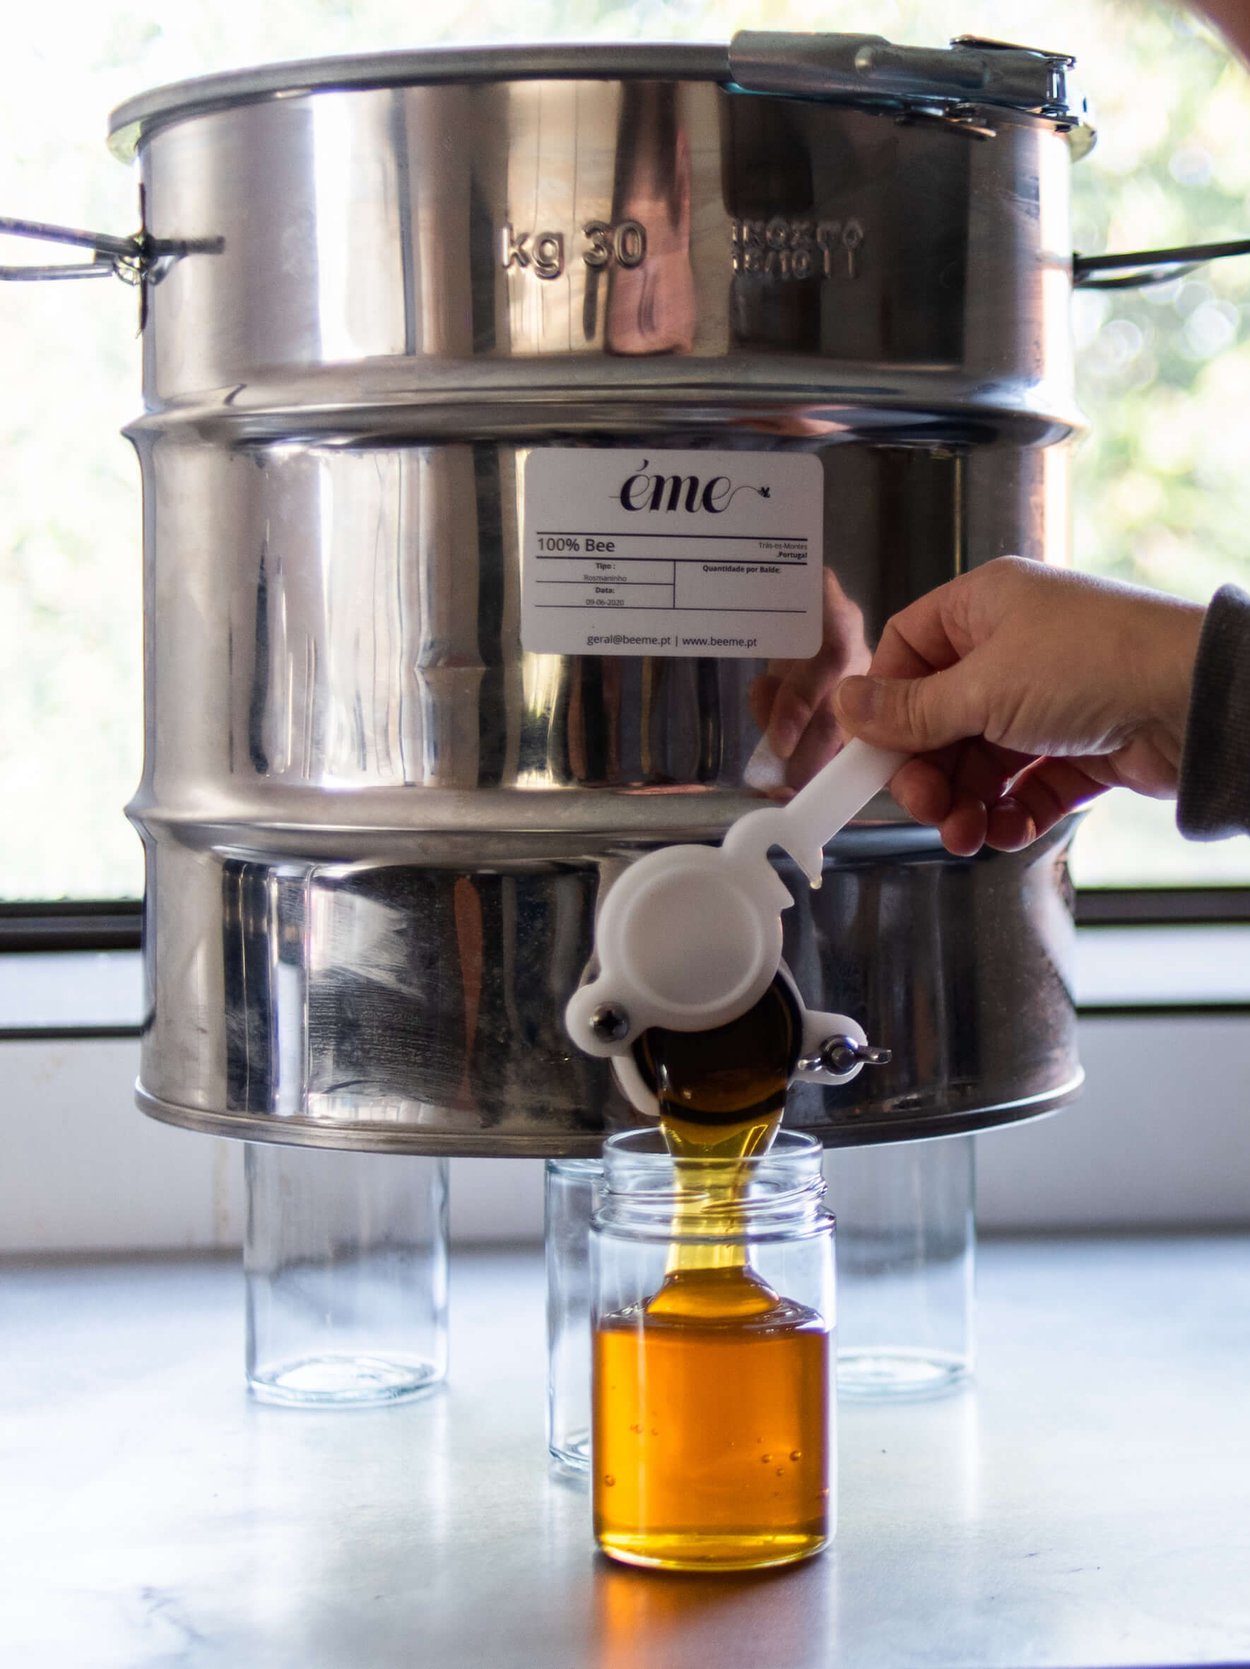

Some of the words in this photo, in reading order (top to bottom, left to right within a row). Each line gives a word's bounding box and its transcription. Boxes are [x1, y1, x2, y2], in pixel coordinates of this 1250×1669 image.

[502, 222, 564, 279] kg
[582, 220, 647, 269] 30
[537, 538, 580, 551] 100%
[585, 539, 615, 552] Bee
[595, 562, 612, 570] Tipo
[702, 564, 745, 573] Quantidade
[759, 565, 782, 573] Balde:
[595, 586, 615, 594] Data:
[587, 634, 671, 647] geral@beeme.pt
[682, 636, 758, 648] www.beeme.pt
